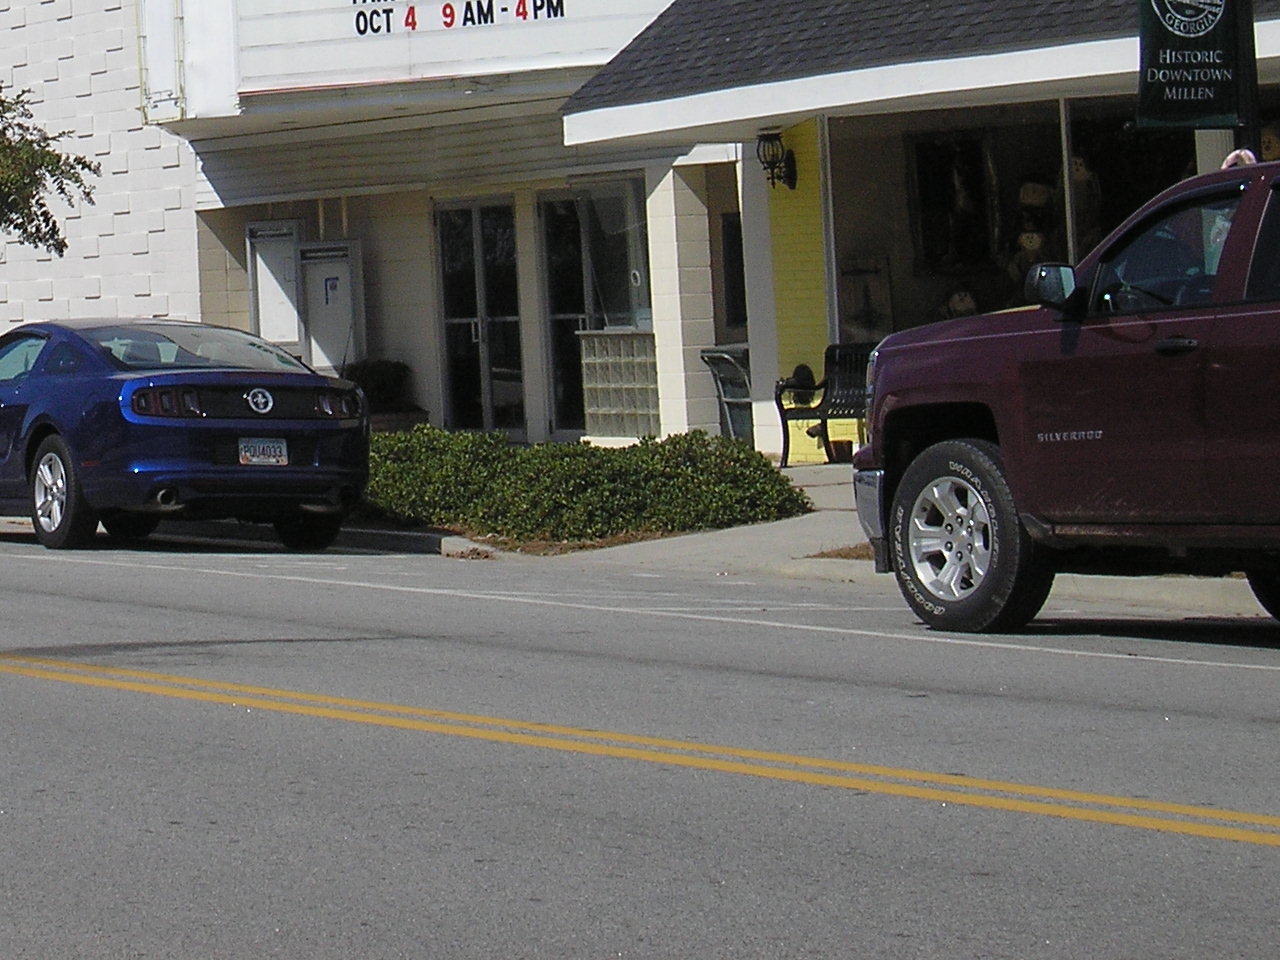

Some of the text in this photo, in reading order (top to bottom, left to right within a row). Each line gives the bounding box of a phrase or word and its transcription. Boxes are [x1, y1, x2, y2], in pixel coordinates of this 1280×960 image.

[354, 8, 394, 36] OCT
[404, 5, 417, 31] 4
[1166, 13, 1216, 33] GEORGIA
[1159, 49, 1224, 64] HISTORIC
[1147, 68, 1233, 82] DOWNTOWN
[1163, 86, 1214, 100] MILLEN
